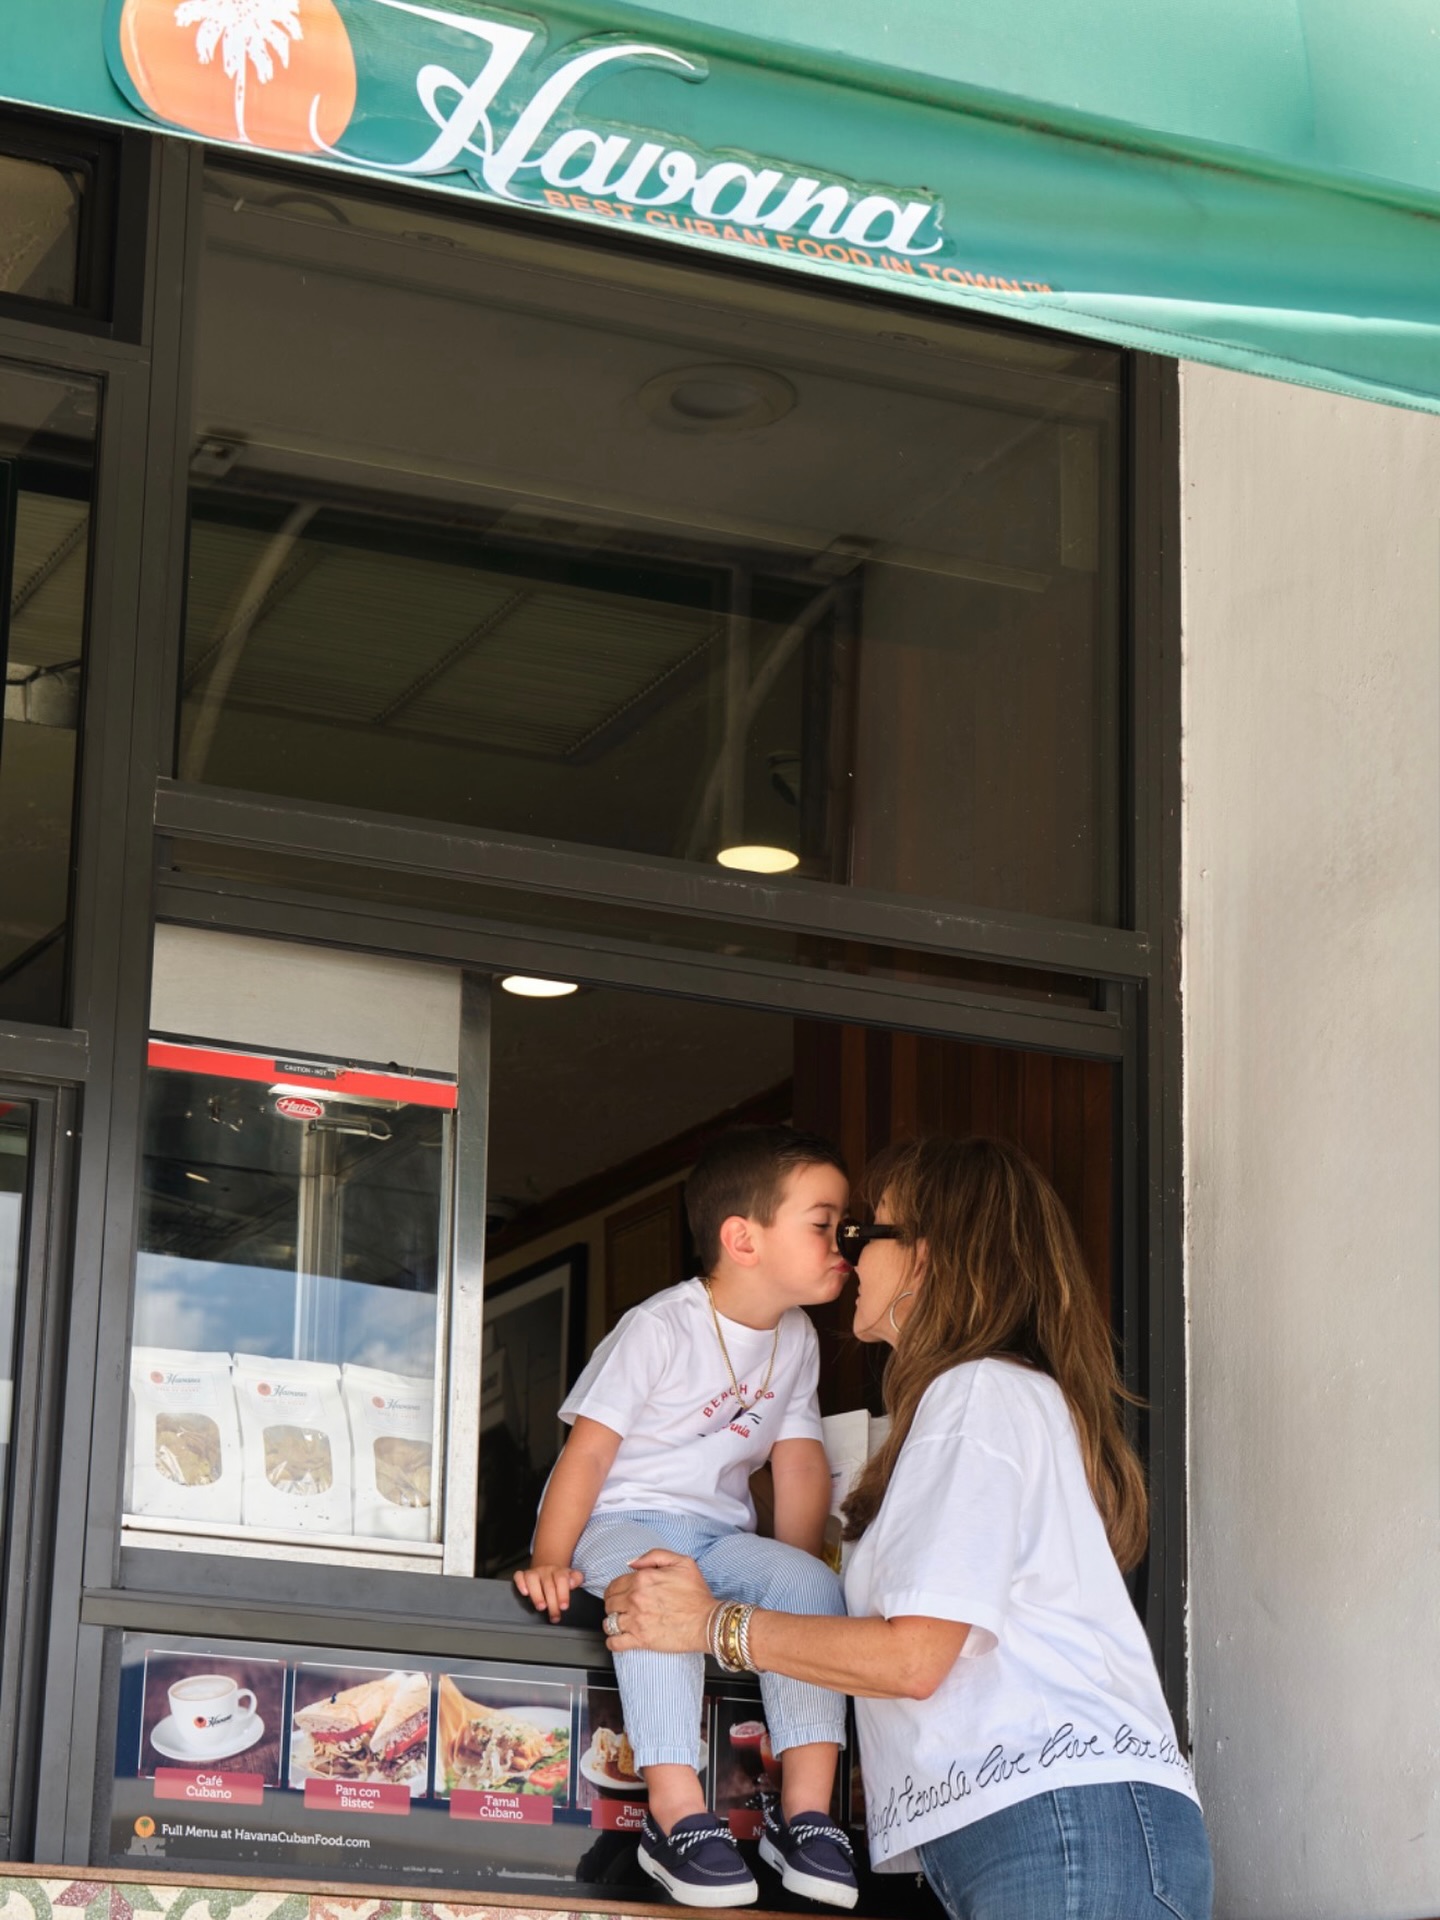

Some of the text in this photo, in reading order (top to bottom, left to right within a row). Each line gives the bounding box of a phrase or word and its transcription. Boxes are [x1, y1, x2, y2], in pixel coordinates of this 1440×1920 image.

[309, 0, 943, 256] Havana
[543, 189, 634, 221] BEST
[646, 210, 769, 248] CUBAN
[775, 235, 873, 268] FOOD
[880, 255, 915, 275] IN
[196, 1774, 223, 1787] Café
[186, 1785, 232, 1799] Cubano
[335, 1784, 381, 1798] Pan con
[341, 1796, 375, 1809] Bistec
[484, 1795, 520, 1808] Tamal
[480, 1806, 524, 1819] Cubano
[623, 1805, 645, 1817] Flan
[615, 1816, 643, 1828] Cara
[161, 1823, 371, 1849] Full Menu at HavanaCubanFood.com
